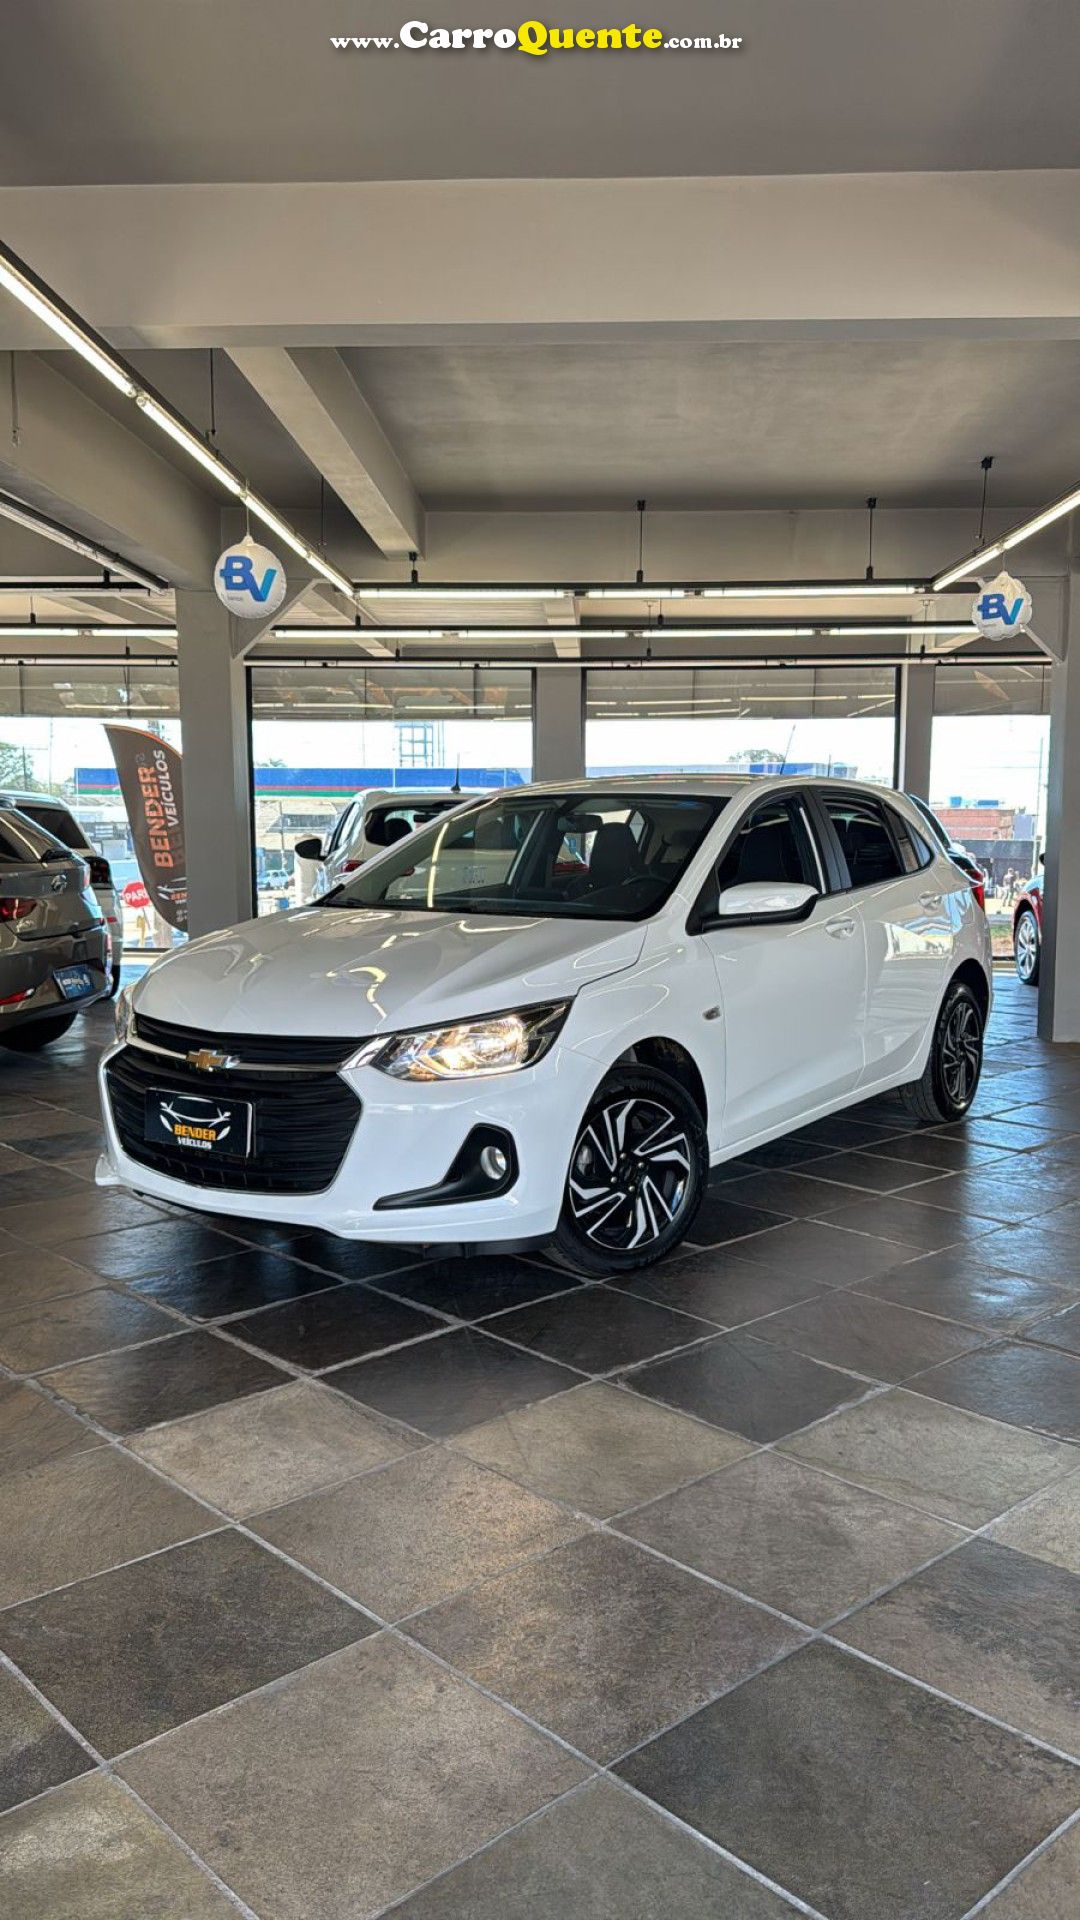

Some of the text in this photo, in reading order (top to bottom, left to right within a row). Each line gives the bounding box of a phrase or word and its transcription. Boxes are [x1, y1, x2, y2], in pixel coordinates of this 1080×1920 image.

[219, 555, 277, 602] BV
[977, 593, 1024, 625] BV
[153, 749, 179, 827] VEÍCULOS
[137, 765, 174, 868] BENDER
[174, 1124, 216, 1140] BENDER
